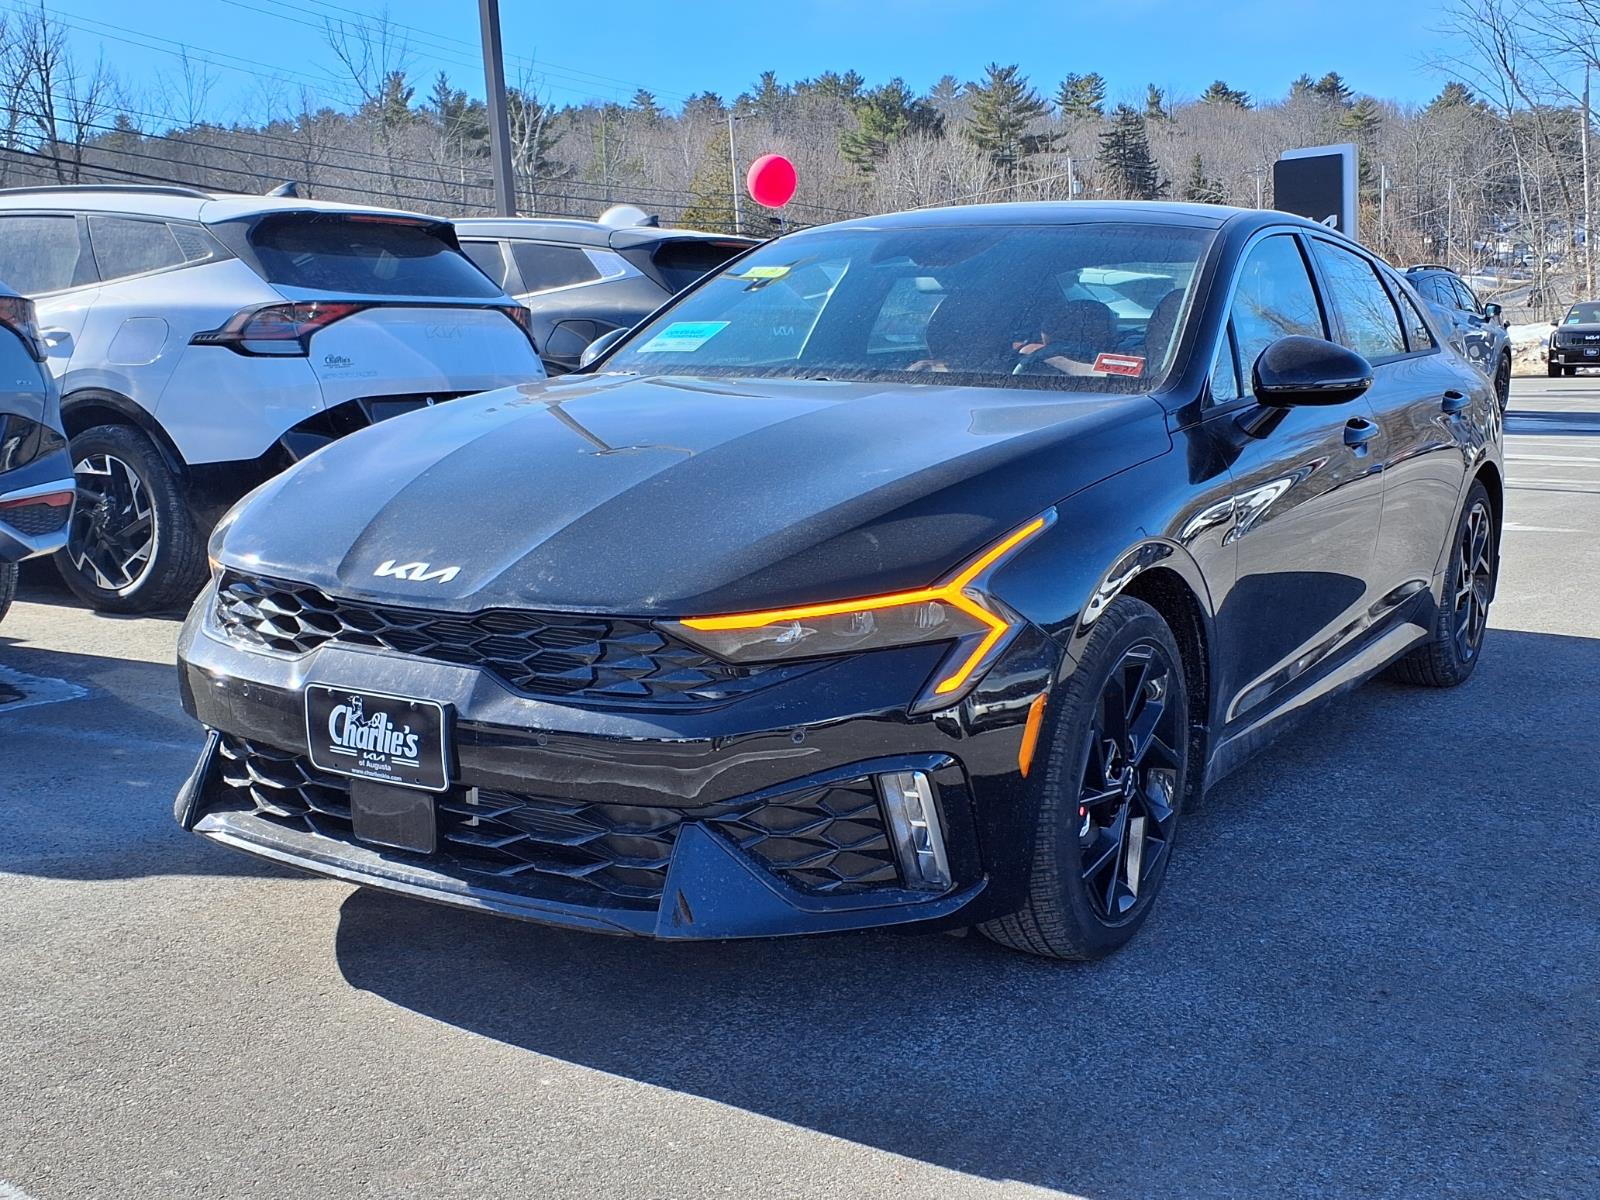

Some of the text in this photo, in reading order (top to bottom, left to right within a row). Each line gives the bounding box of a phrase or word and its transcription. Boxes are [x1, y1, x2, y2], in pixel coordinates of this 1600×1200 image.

[773, 326, 794, 337] KIA
[373, 559, 461, 584] KIA
[328, 704, 419, 758] Charlie's
[363, 752, 386, 761] KIA
[366, 761, 391, 771] Augusta
